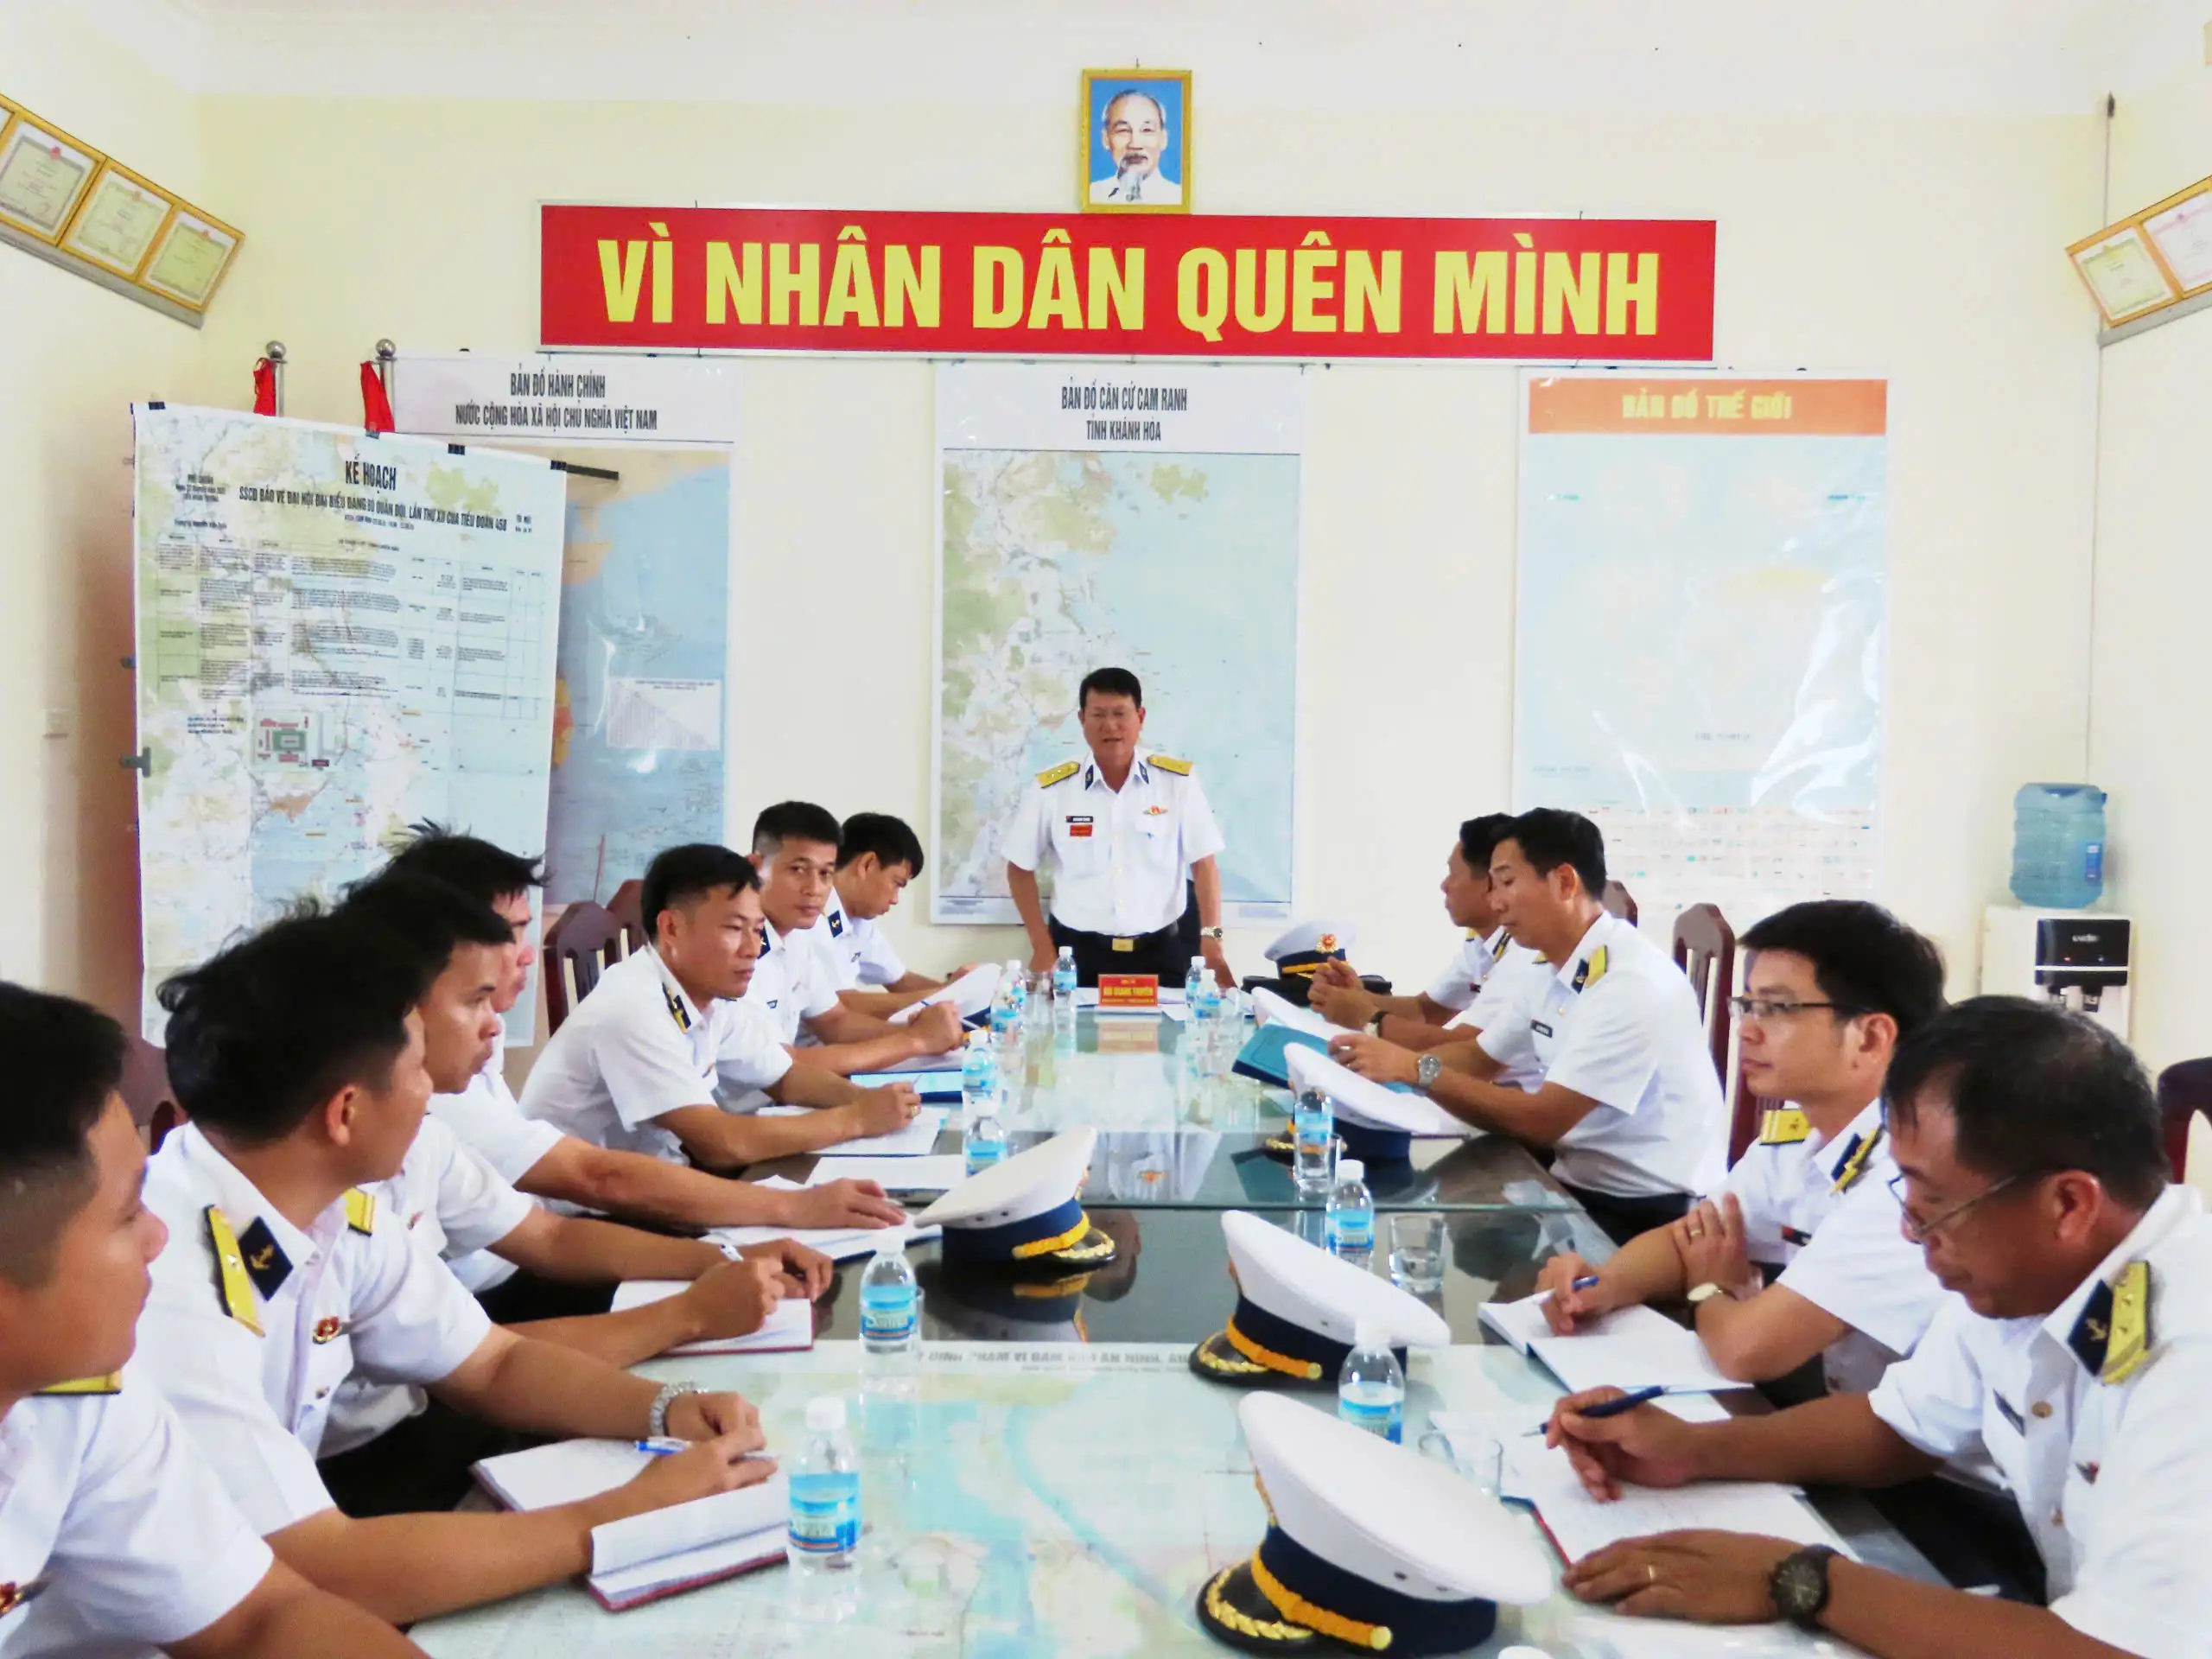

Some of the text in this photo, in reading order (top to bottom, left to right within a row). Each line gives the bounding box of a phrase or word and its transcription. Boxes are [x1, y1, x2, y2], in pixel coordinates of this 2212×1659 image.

[598, 222, 1659, 342] VÌ NHÂN DÂN QUÊN MÌNH
[510, 363, 530, 397] BẢN
[548, 370, 574, 397] HÀNH
[576, 369, 606, 398] CHÍNH
[1061, 376, 1081, 410] BẢN
[1099, 382, 1119, 410] CĂN
[1122, 380, 1136, 410] CỨ
[1137, 388, 1159, 411] CAM
[1161, 388, 1188, 411] RANH
[455, 399, 658, 434] NƯỚC CỘNG HÒA XÃ HỘI CHỦ NGHĨA VIỆT NAM
[1622, 386, 1665, 419] BẢN
[1706, 388, 1746, 420] THẾ
[1086, 412, 1161, 442] TỈNH KHÁNH HÒA
[345, 453, 397, 494] KẾ HOẠCH
